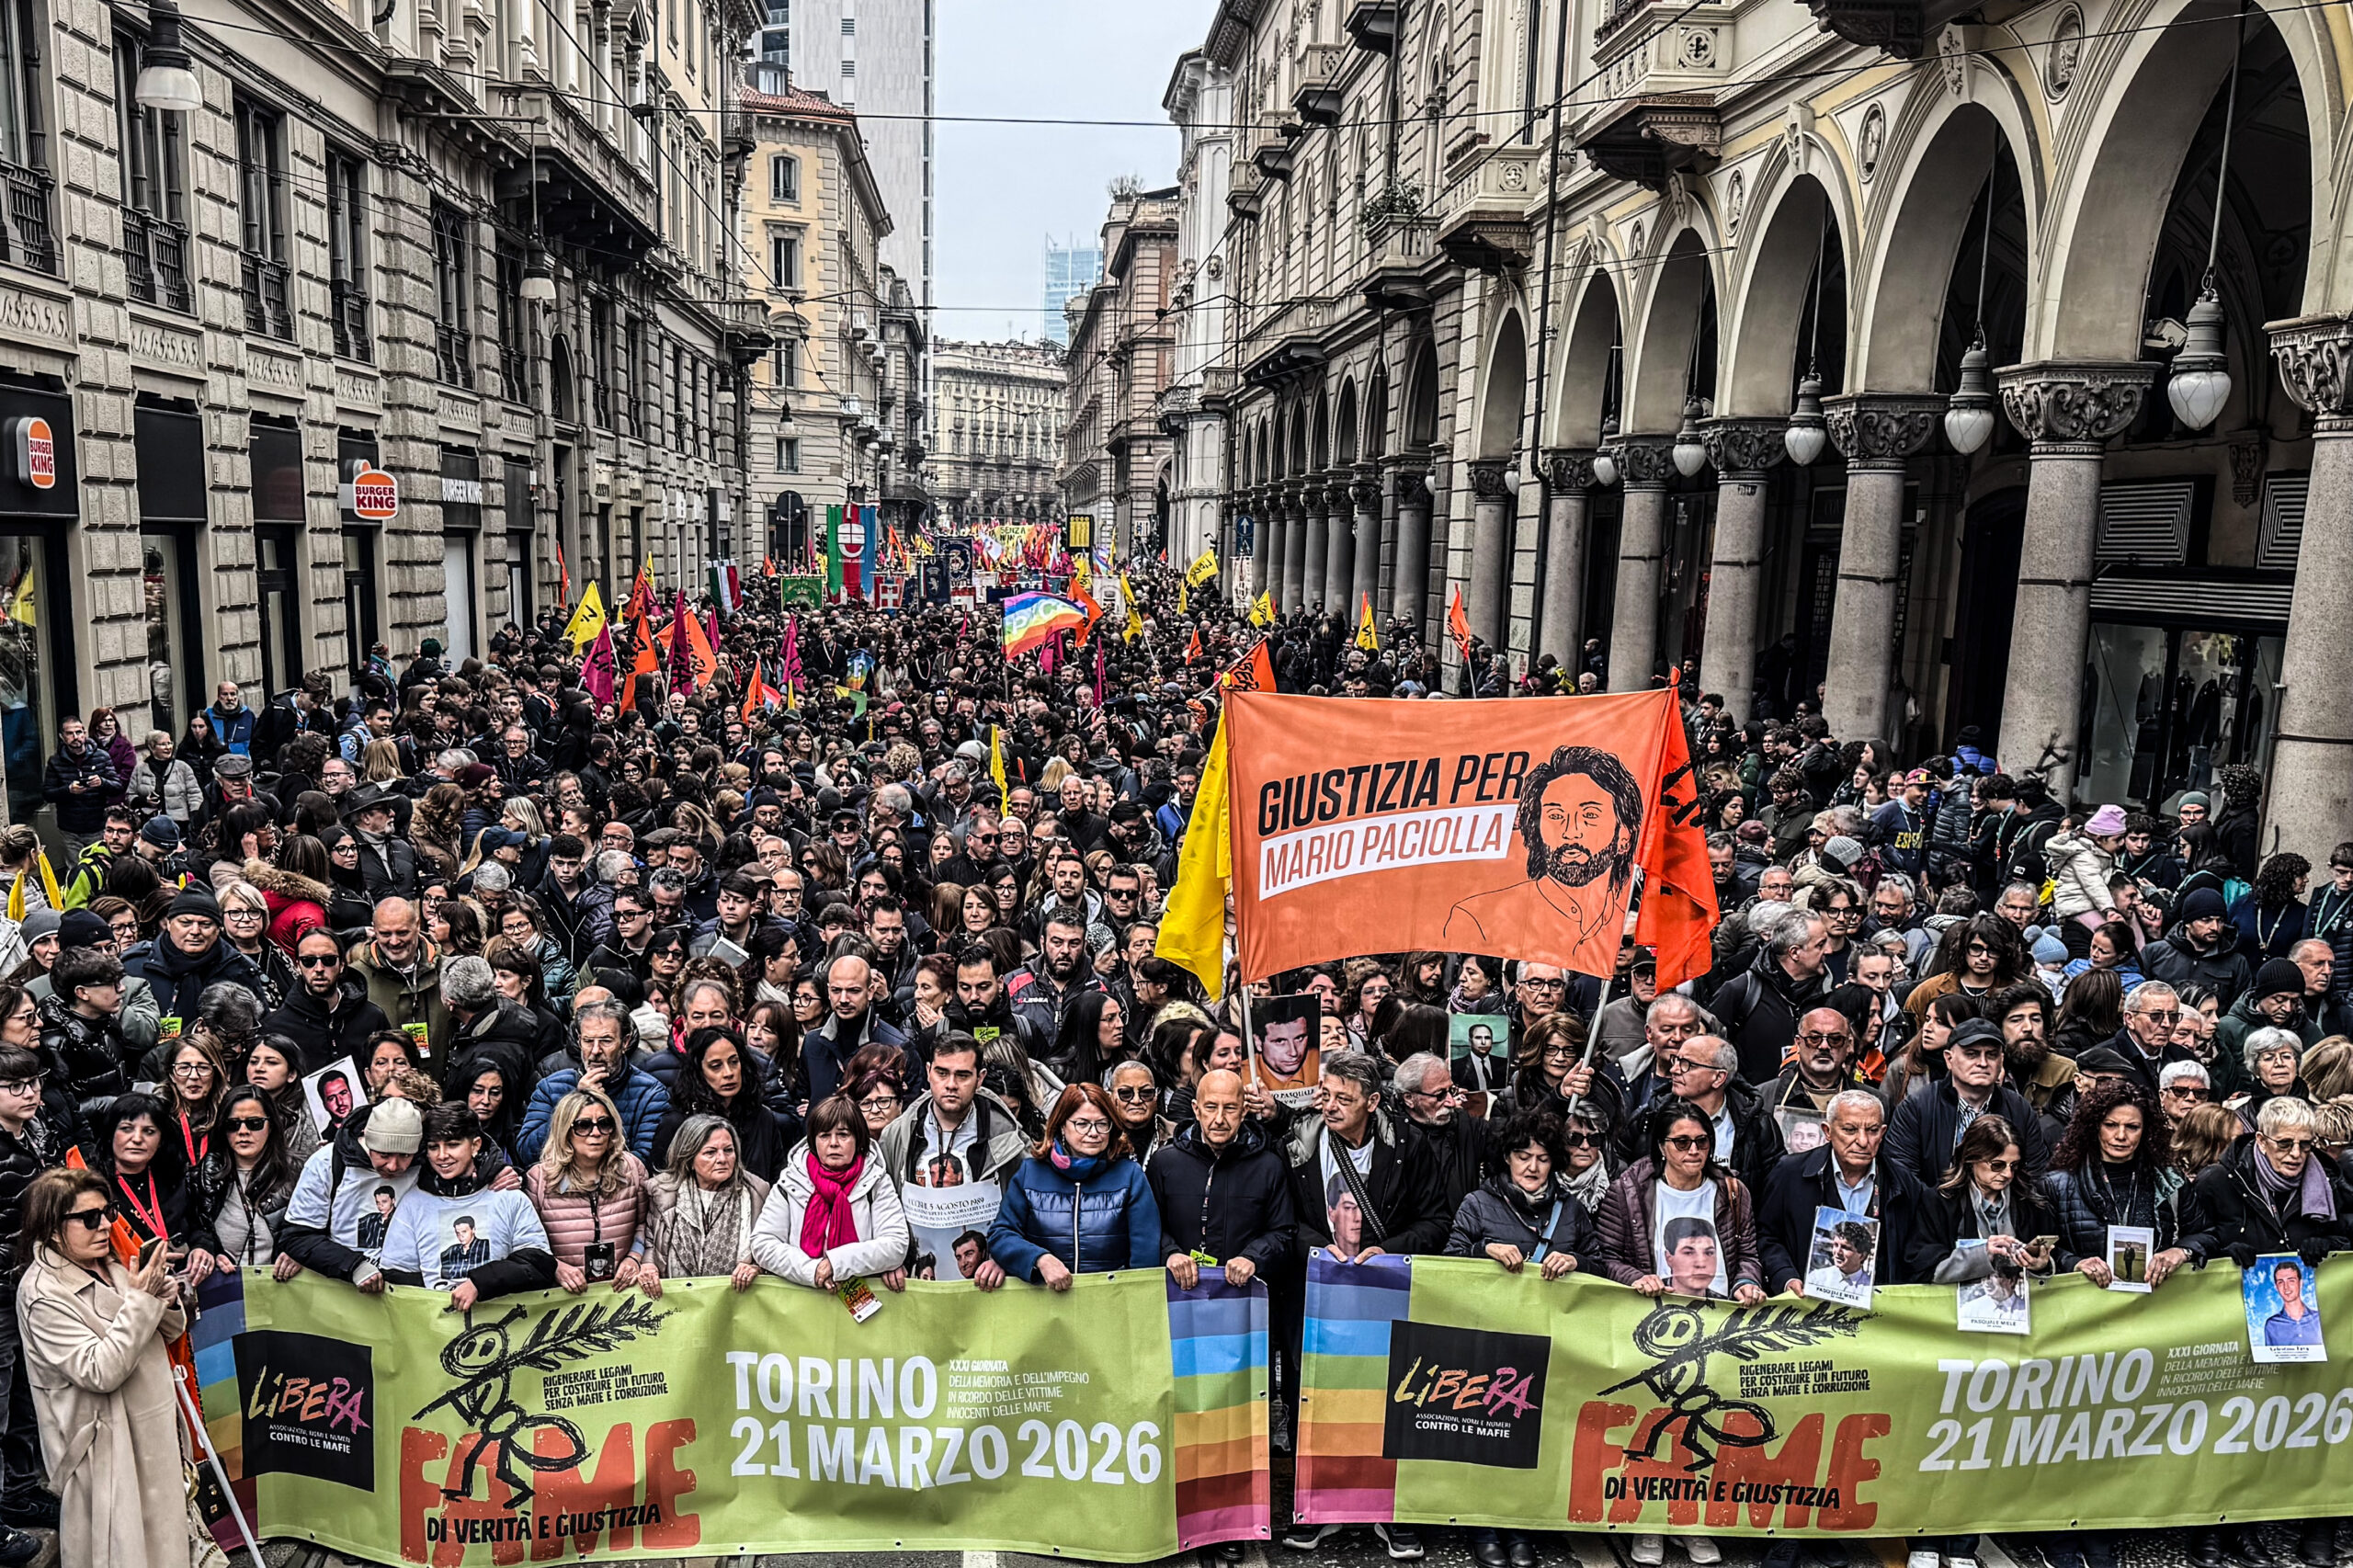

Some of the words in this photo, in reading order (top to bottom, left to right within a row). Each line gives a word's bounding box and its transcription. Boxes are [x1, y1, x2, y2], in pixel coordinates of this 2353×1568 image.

[29, 439, 52, 455] BURGER
[30, 454, 53, 474] KING
[355, 485, 395, 496] BURGER
[441, 478, 467, 503] BURGER
[467, 481, 483, 505] KING
[356, 496, 396, 509] KING
[1258, 757, 1440, 836] GIUSTIZIA
[1449, 751, 1529, 804] PER
[1266, 830, 1355, 891] MARIO
[1359, 813, 1502, 866] PACIOLLA
[937, 1199, 970, 1210] AGOSTO
[2167, 1347, 2191, 1359] XXXI
[2193, 1341, 2239, 1357] GIORNATA
[949, 1359, 970, 1372] XXXI
[971, 1360, 1009, 1372] GIORNATA
[1739, 1362, 1796, 1377] RIGENERARE
[1799, 1360, 1833, 1372] LEGAMI
[2164, 1360, 2192, 1373] DELLA
[2194, 1356, 2237, 1369] MEMORIA
[2239, 1354, 2245, 1365] E
[543, 1369, 597, 1388] RIGENERARE
[599, 1364, 632, 1379] LEGAMI
[949, 1375, 972, 1388] DELLA
[972, 1375, 1012, 1388] MEMORIA
[1014, 1375, 1020, 1386] E
[1023, 1370, 1089, 1384] DELL'IMPEGNO
[1740, 1376, 1757, 1387] PER
[1759, 1373, 1811, 1386] COSTRUIRE
[1814, 1372, 1828, 1383] UN
[1831, 1369, 1868, 1382] FUTURO
[1937, 1347, 2154, 1415] TORINO
[2160, 1375, 2171, 1385] IN
[2172, 1369, 2213, 1384] RICORDO
[2215, 1366, 2243, 1380] DELLE
[2245, 1364, 2279, 1377] VITTIME
[544, 1386, 561, 1400] PER
[563, 1379, 612, 1397] COSTRUIRE
[615, 1377, 628, 1389] UN
[631, 1371, 665, 1386] FUTURO
[726, 1350, 938, 1420] TORINO
[948, 1391, 957, 1403] IN
[958, 1392, 993, 1403] RICORDO
[995, 1390, 1025, 1403] DELLE
[1026, 1386, 1063, 1399] VITTIME
[1740, 1386, 1769, 1399] SENZA
[1772, 1384, 1801, 1397] MAFIE
[1804, 1383, 1809, 1394] E
[1813, 1380, 1870, 1393] CORRUZIONE
[2156, 1384, 2206, 1397] INNOCENTI
[2207, 1382, 2234, 1393] DELLE
[2235, 1379, 2265, 1390] MAFIE
[545, 1396, 574, 1411] SENZA
[577, 1391, 604, 1407] MAFIE
[607, 1391, 612, 1402] E
[614, 1382, 668, 1401] CORRUZIONE
[946, 1406, 990, 1419] INNOCENTI
[993, 1403, 1022, 1417] DELLE
[1024, 1401, 1052, 1414] MAFIE
[1415, 1421, 1459, 1432] CONTRO
[1461, 1425, 1473, 1434] LE
[1476, 1426, 1510, 1438] MAFIE
[1919, 1416, 1993, 1471] 21
[2001, 1400, 2208, 1468] MARZO
[2213, 1388, 2353, 1454] 2026
[269, 1431, 308, 1446] CONTRO
[310, 1438, 321, 1448] LE
[323, 1440, 351, 1454] MAFIE
[731, 1416, 800, 1479] 21
[806, 1425, 1009, 1490] MARZO
[1017, 1418, 1162, 1485] 2026
[1567, 1401, 1892, 1530] FAME
[399, 1418, 701, 1568] FAME
[1604, 1477, 1627, 1500] DI
[1632, 1474, 1711, 1502] VERITÀ
[1713, 1481, 1727, 1502] E
[1732, 1482, 1840, 1509] GIUSTIZIA
[427, 1517, 447, 1543] DI
[454, 1510, 532, 1544] VERITÀ
[539, 1515, 550, 1540] E
[555, 1503, 661, 1538] GIUSTIZIA
